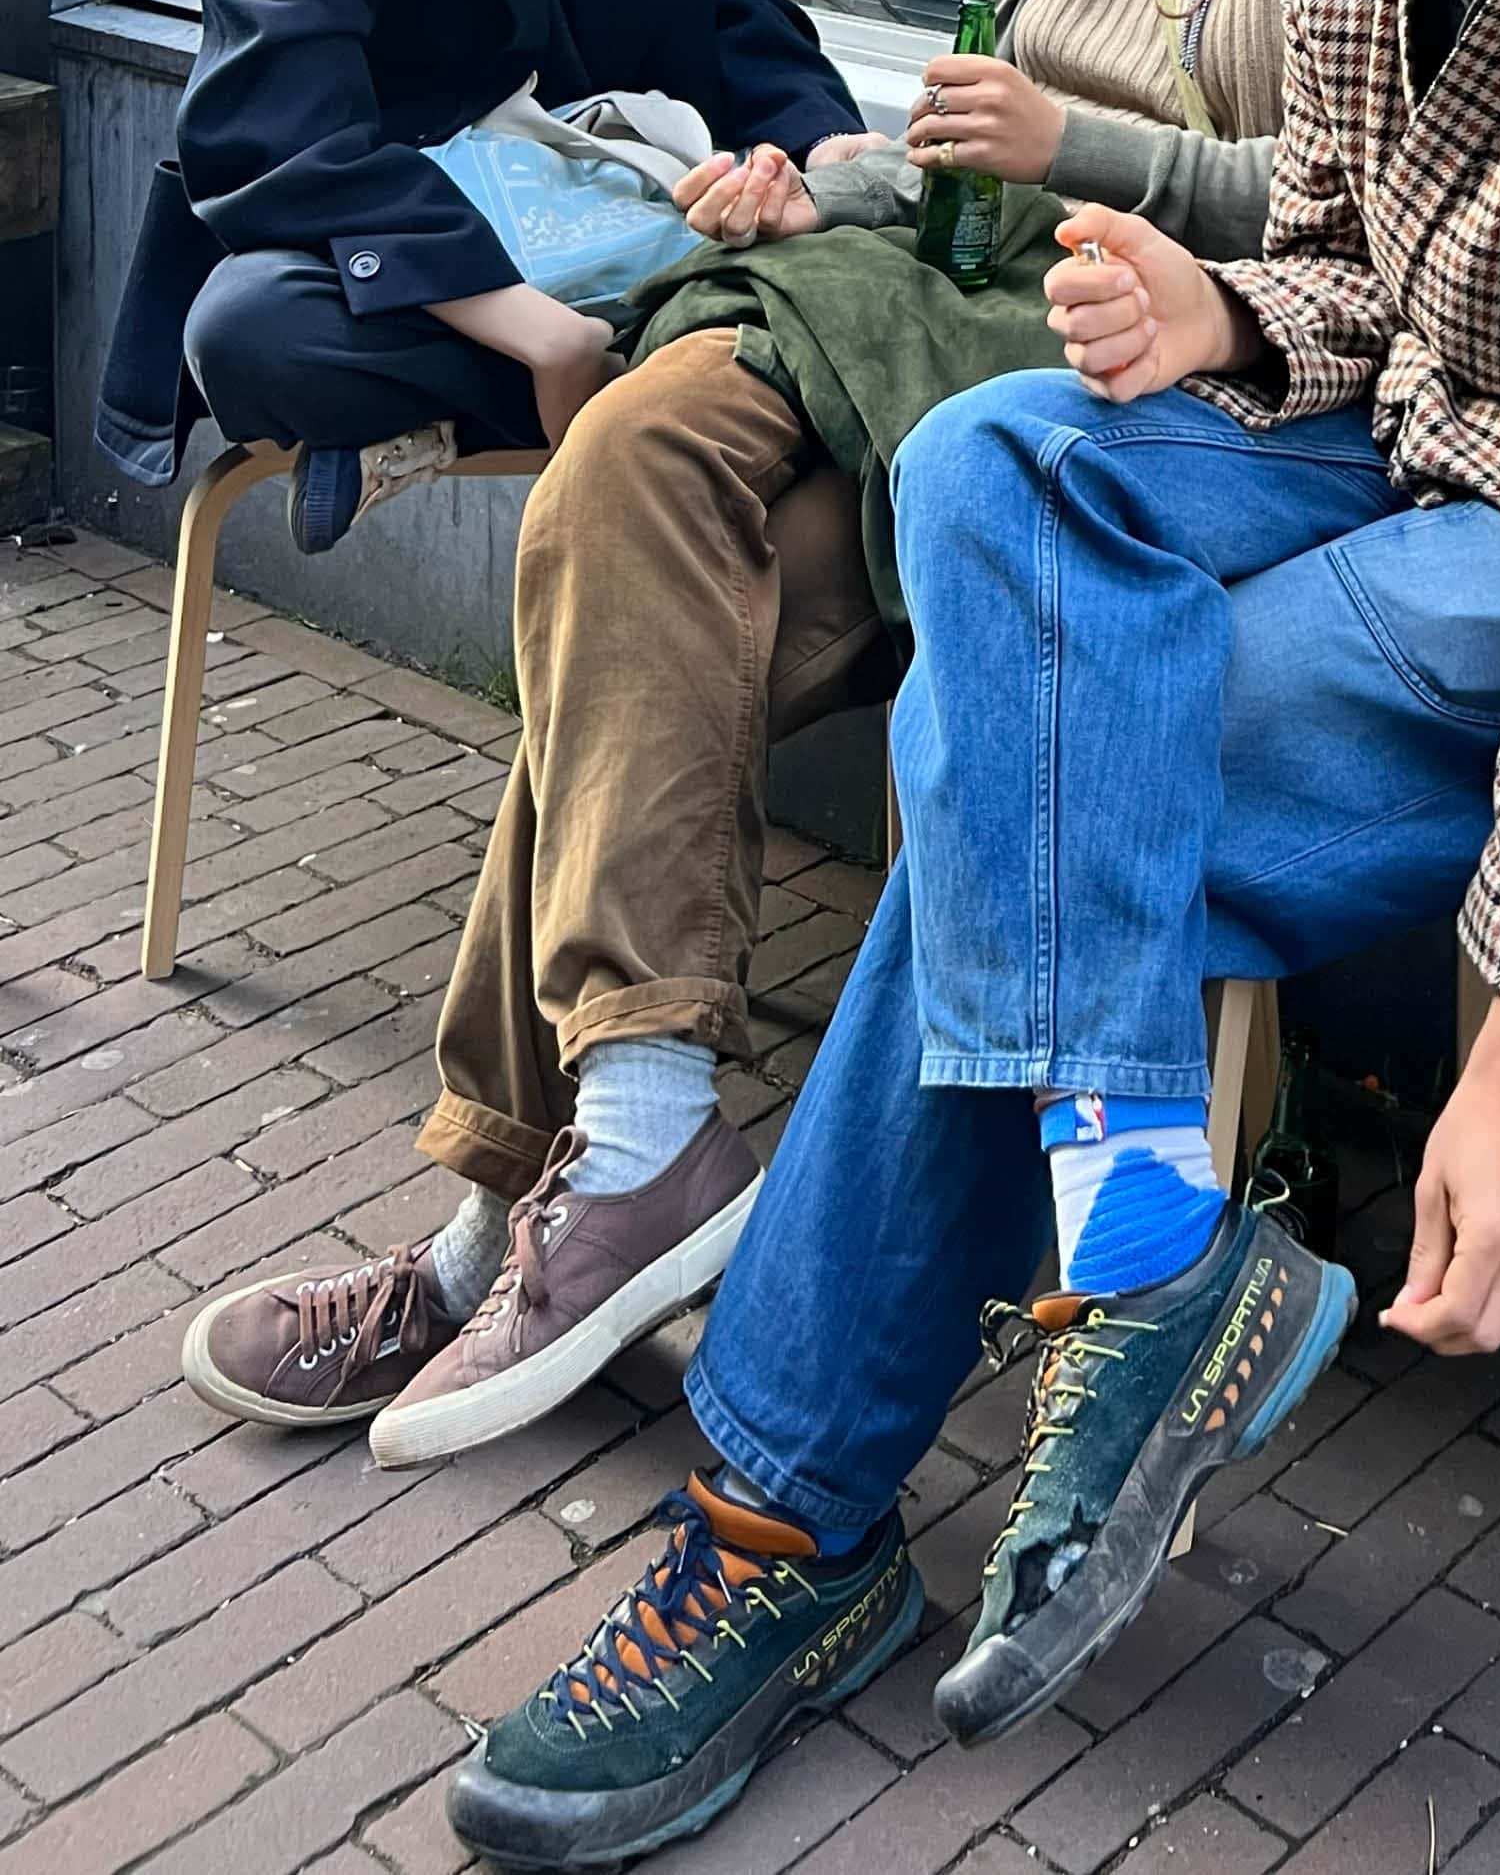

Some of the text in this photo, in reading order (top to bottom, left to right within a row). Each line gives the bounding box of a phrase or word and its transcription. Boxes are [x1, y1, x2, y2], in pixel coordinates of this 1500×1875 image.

[1182, 1257, 1273, 1425] LA SPORTIVA
[793, 1650, 820, 1680] LA
